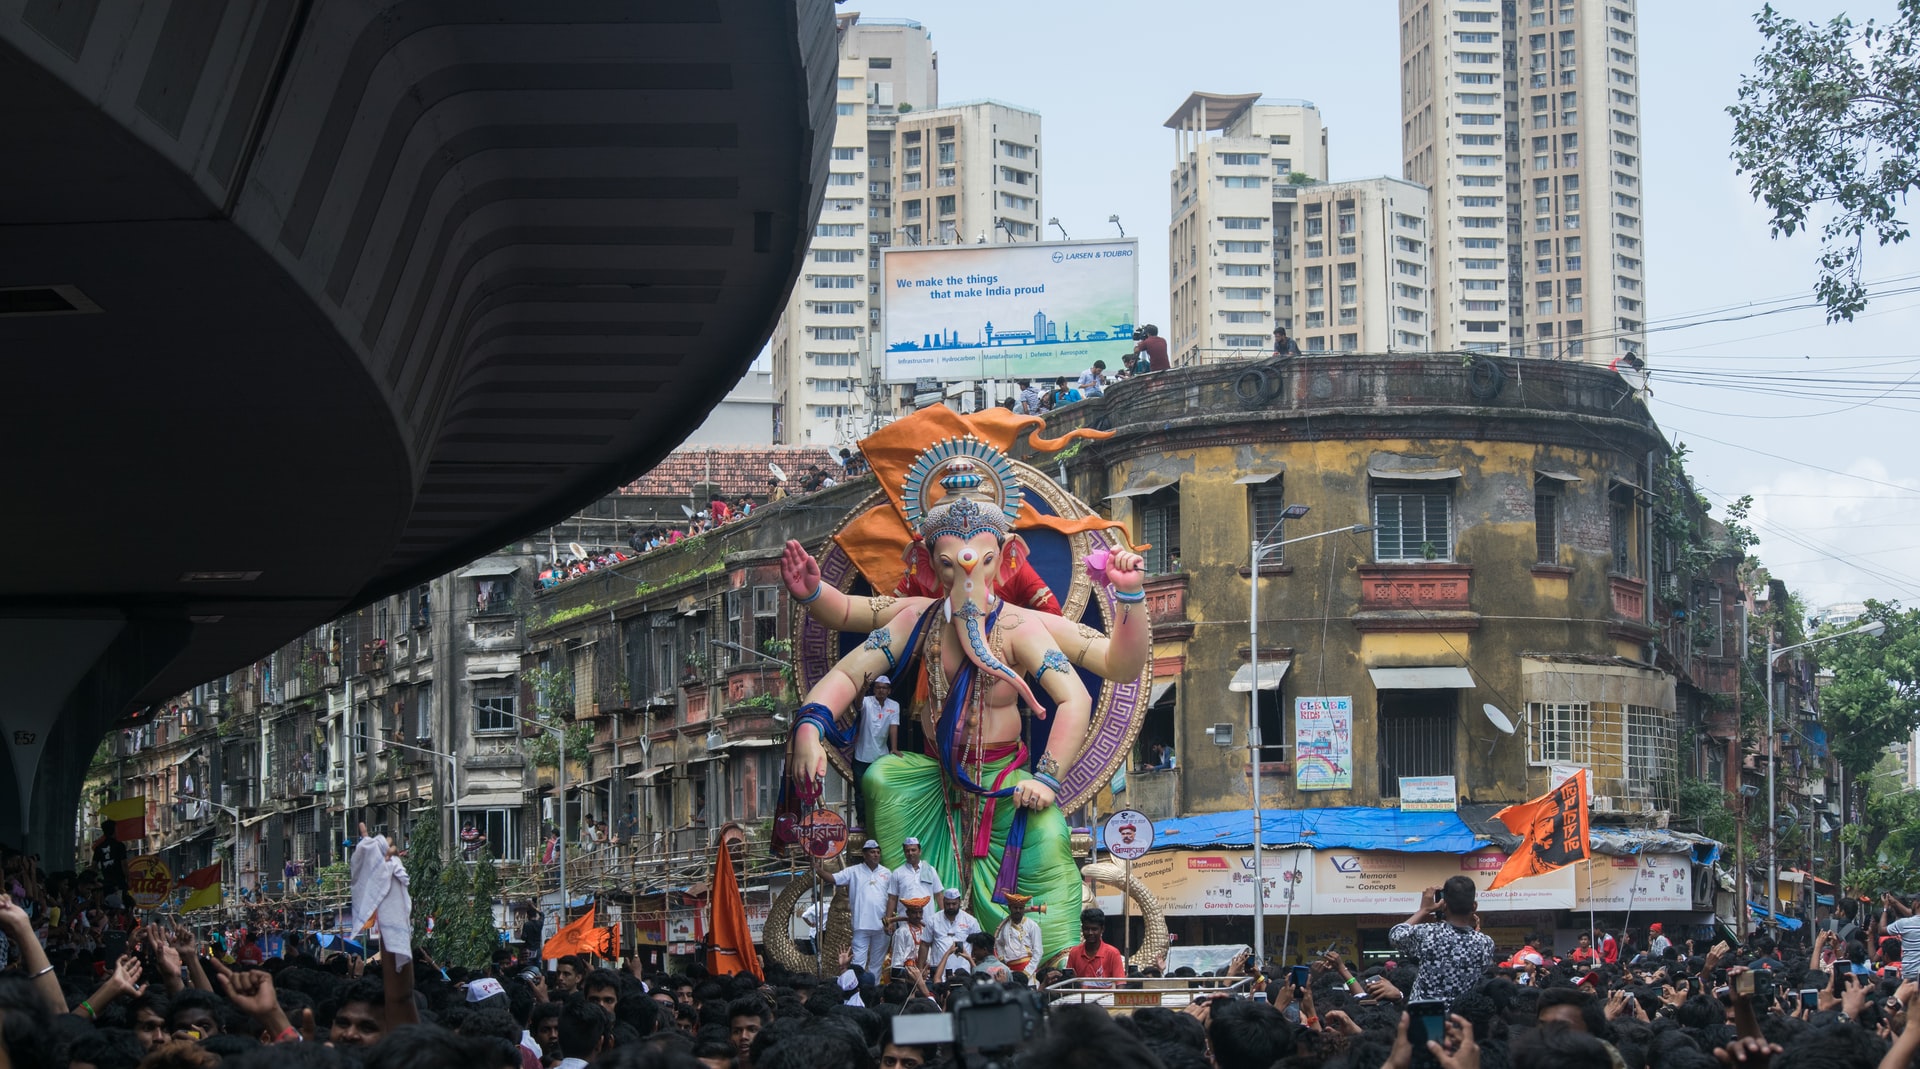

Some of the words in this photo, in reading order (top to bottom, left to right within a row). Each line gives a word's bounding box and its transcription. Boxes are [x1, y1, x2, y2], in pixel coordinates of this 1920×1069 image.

[1066, 252, 1093, 260] LARSEN
[1103, 249, 1133, 258] TOUBRO
[896, 278, 912, 288] We
[915, 276, 943, 287] make
[946, 275, 963, 286] the
[966, 274, 998, 286] things
[930, 288, 951, 299] that
[954, 287, 982, 298] make
[986, 286, 1011, 297] India
[1014, 284, 1045, 297] proud
[942, 355, 976, 363] Hydrocarbon
[983, 352, 1022, 361] Manufacturing
[1030, 350, 1052, 358] Defence
[1300, 701, 1347, 711] CLEVER
[1300, 711, 1320, 720] KIDS
[1132, 859, 1163, 869] Memories
[1359, 872, 1397, 880] Memories
[1358, 883, 1396, 891] Concepts
[1118, 994, 1159, 1004] MALAD
